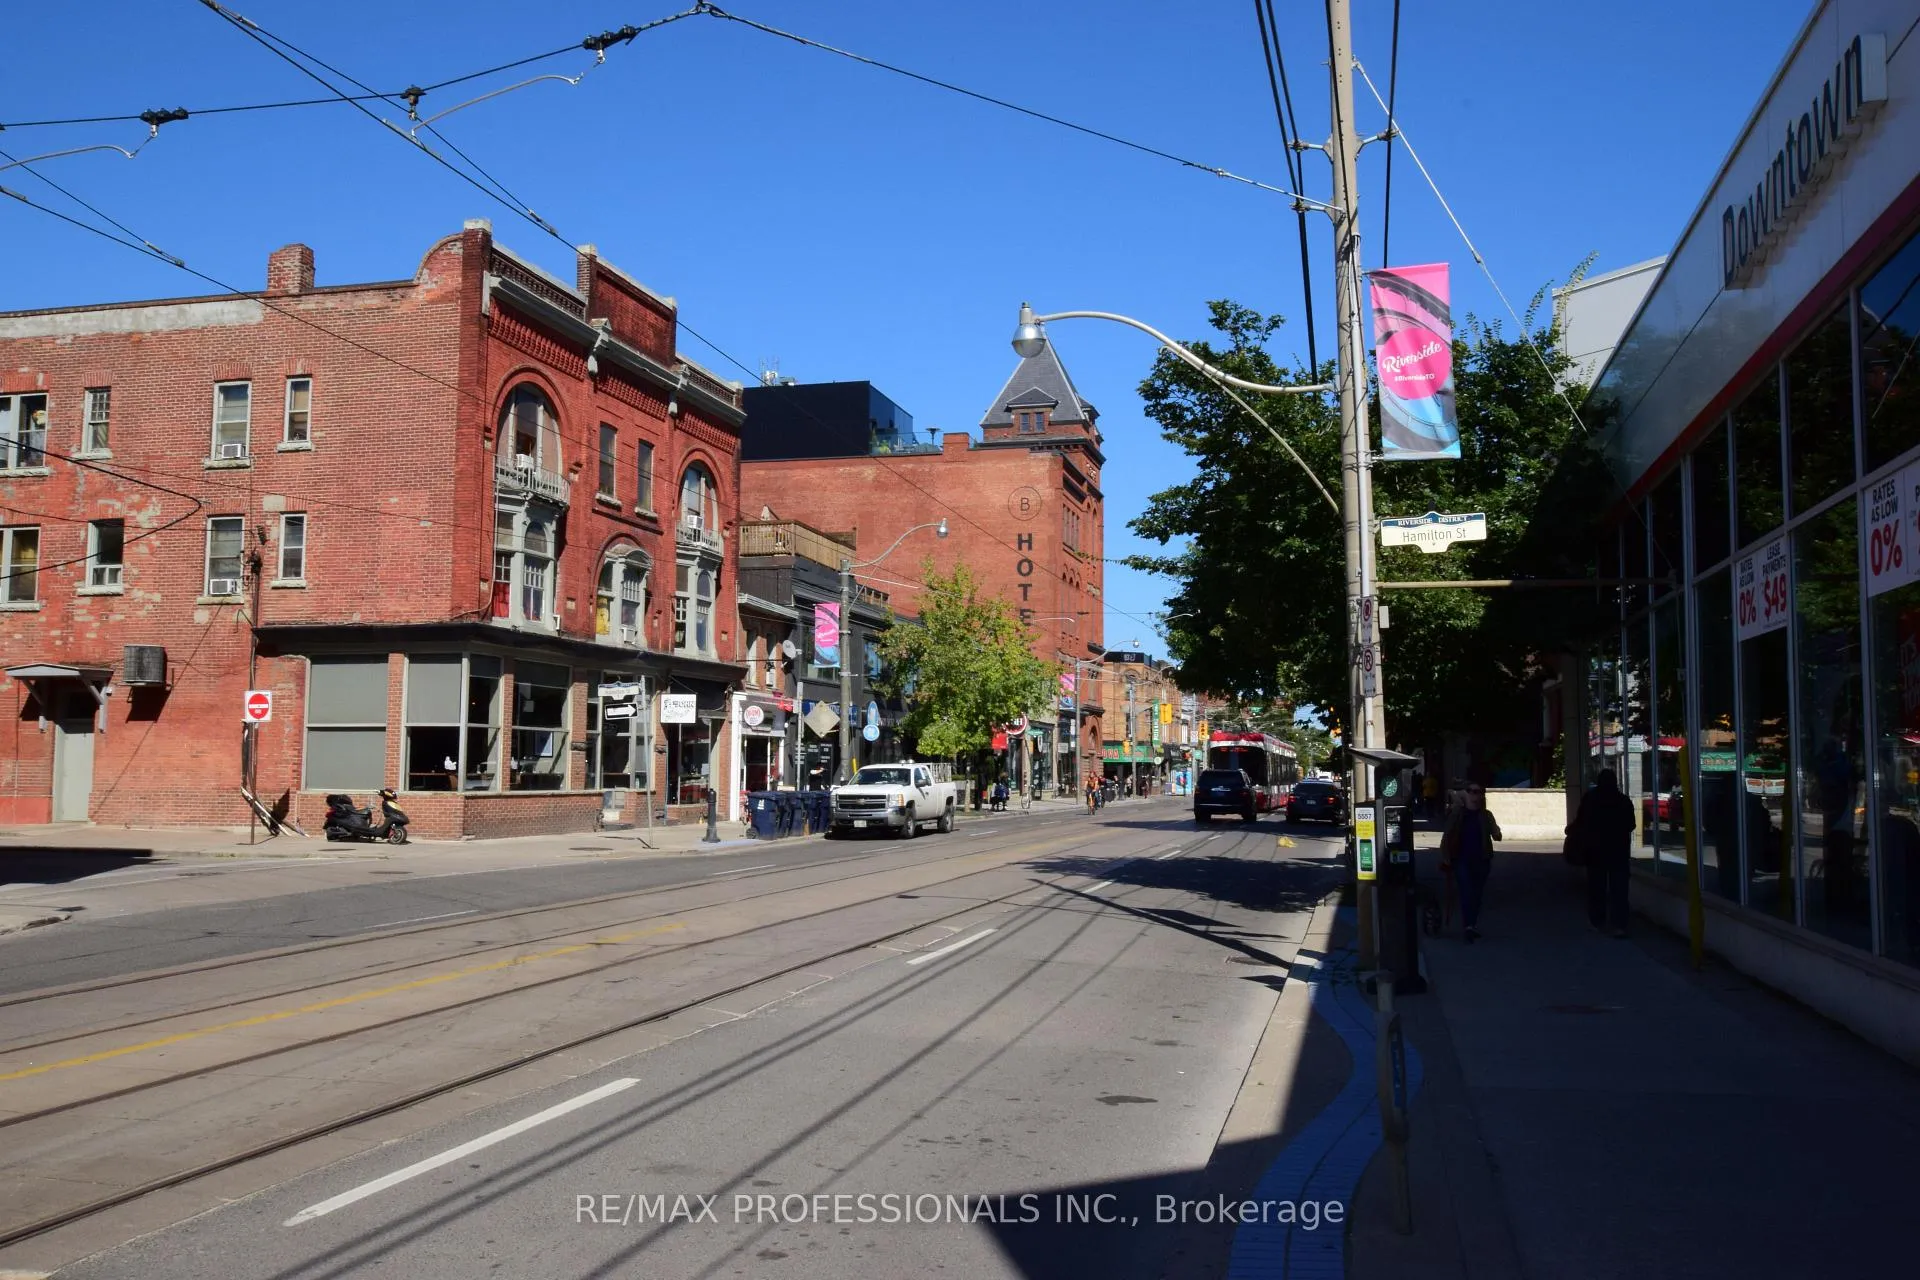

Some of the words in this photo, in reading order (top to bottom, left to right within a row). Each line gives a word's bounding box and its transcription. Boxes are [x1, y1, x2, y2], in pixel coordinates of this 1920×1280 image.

[1723, 34, 1865, 290] Downtown
[1382, 341, 1442, 373] Riverside
[1872, 479, 1896, 504] RATES
[1020, 497, 1031, 512] B
[1871, 506, 1880, 523] AS
[1881, 501, 1898, 520] LOW
[1397, 518, 1433, 527] RIVERSIDE
[1438, 516, 1468, 524] DISTRICT
[1402, 529, 1452, 543] Hamilton
[1456, 528, 1467, 539] St
[1766, 543, 1781, 561] LEASE
[1870, 519, 1903, 577] 0%
[1740, 558, 1753, 574] RATES
[1762, 557, 1787, 577] PAYMENTS
[1016, 533, 1034, 632] HOTE
[1739, 575, 1745, 587] AS
[1745, 572, 1754, 586] LOW
[1739, 586, 1756, 627] 0%
[1764, 573, 1787, 621] $49
